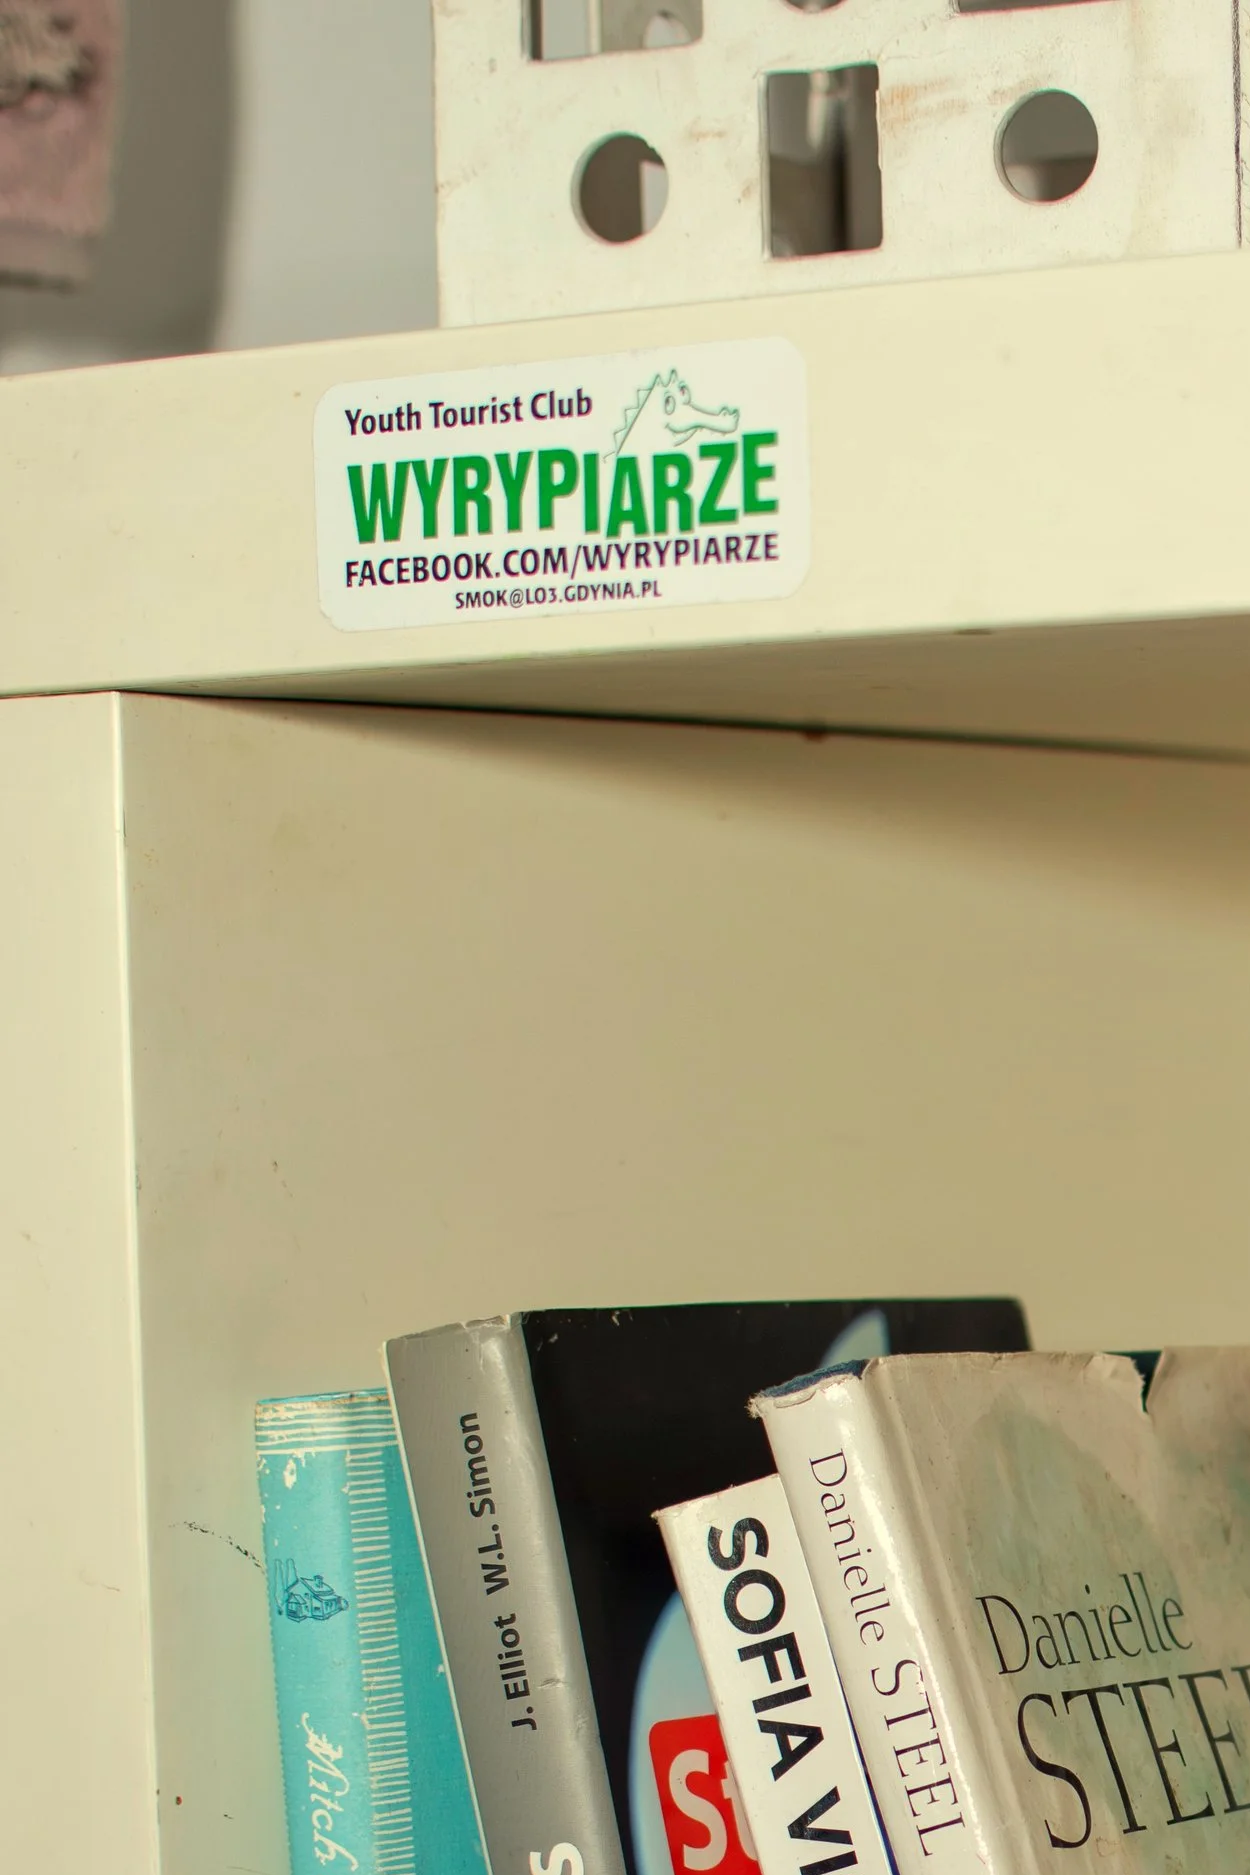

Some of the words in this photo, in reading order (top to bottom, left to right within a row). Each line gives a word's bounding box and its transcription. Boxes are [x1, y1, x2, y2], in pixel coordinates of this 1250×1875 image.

[345, 402, 421, 435] Youth
[429, 395, 523, 429] Tourist
[530, 388, 593, 422] Club
[347, 430, 779, 544] WYRYPIARZE
[345, 532, 780, 588] FACEBOOK.COM/WYRYPIARZE
[455, 581, 662, 610] SMOK@LO3.GDYNIA.PL
[459, 1411, 497, 1518] Simon
[480, 1522, 511, 1597] W.L.
[495, 1612, 531, 1698] Elliot
[706, 1515, 825, 1782] SOFIA
[808, 1447, 891, 1647] Danielle
[870, 1657, 967, 1859] STEEL
[976, 1571, 1194, 1675] Danielle
[512, 1704, 537, 1732] J.
[302, 1712, 359, 1872] Mitch
